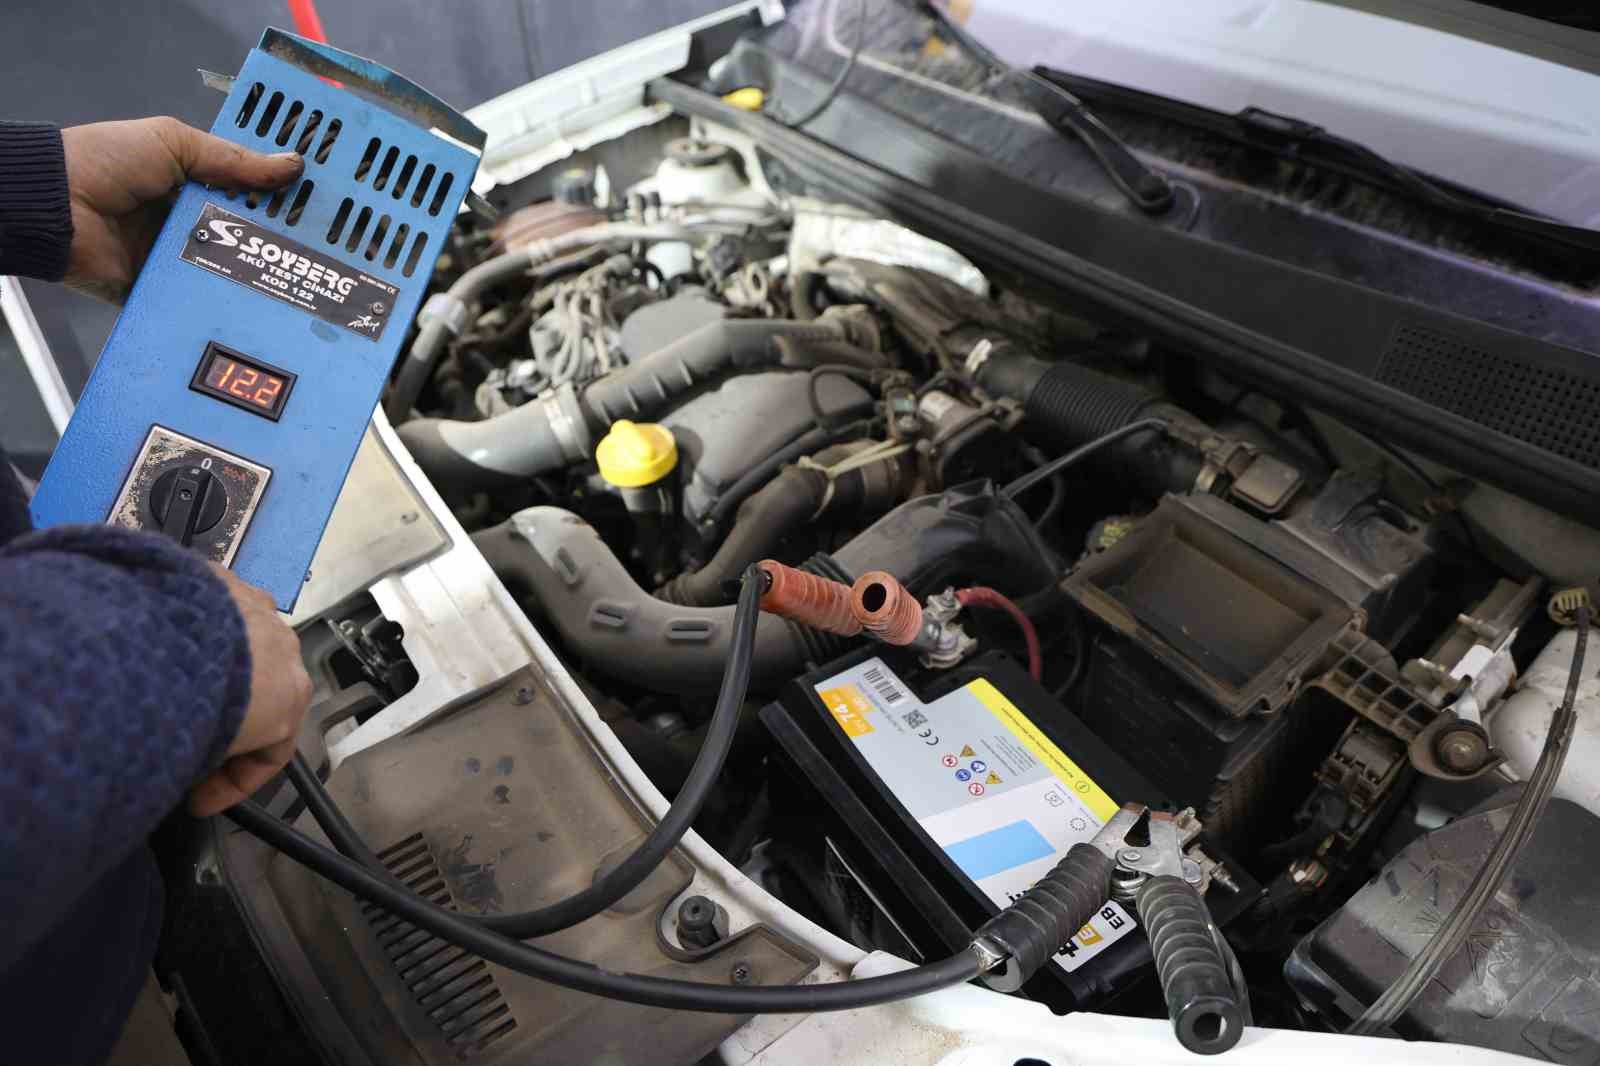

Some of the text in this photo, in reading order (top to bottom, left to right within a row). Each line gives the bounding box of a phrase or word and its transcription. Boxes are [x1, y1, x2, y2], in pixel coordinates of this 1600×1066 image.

[236, 253, 266, 269] AKÜ
[269, 266, 301, 283] TEST
[240, 236, 355, 295] SOYBERG
[261, 273, 315, 301] KOD 122
[201, 458, 213, 470] 0
